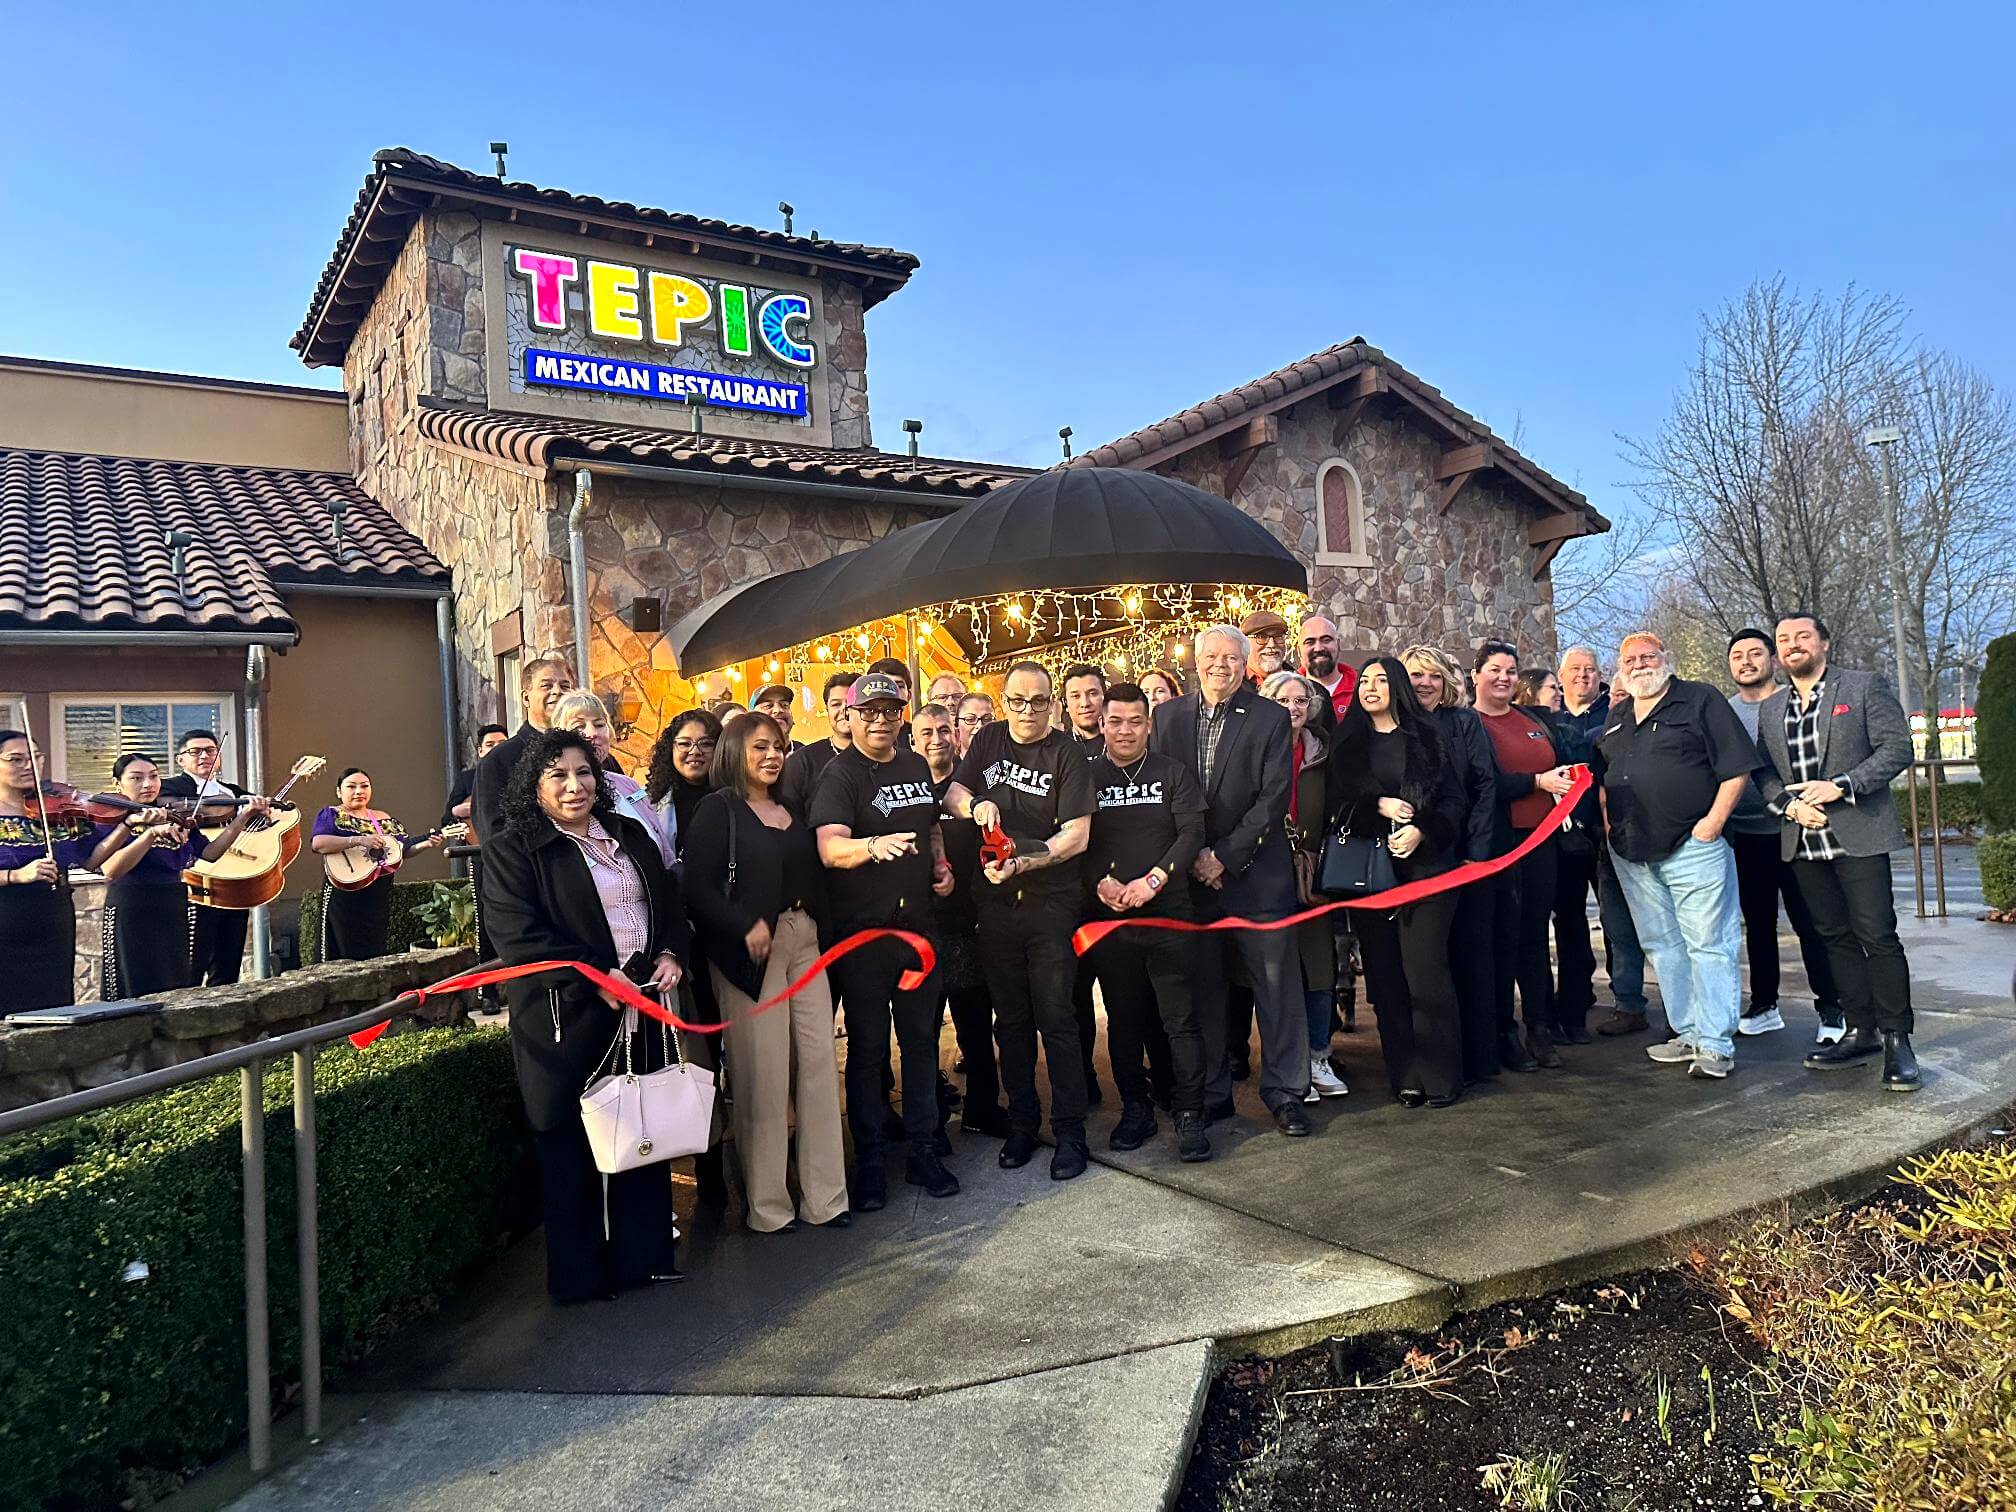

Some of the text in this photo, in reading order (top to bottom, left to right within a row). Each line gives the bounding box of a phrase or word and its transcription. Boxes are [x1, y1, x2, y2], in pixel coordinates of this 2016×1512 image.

[515, 249, 815, 367] TEPIC
[535, 356, 799, 410] MEXICAN RESTAURANT
[1002, 759, 1053, 790] TEPIC
[880, 781, 932, 801] TEPIC
[1105, 781, 1163, 800] TEPIC
